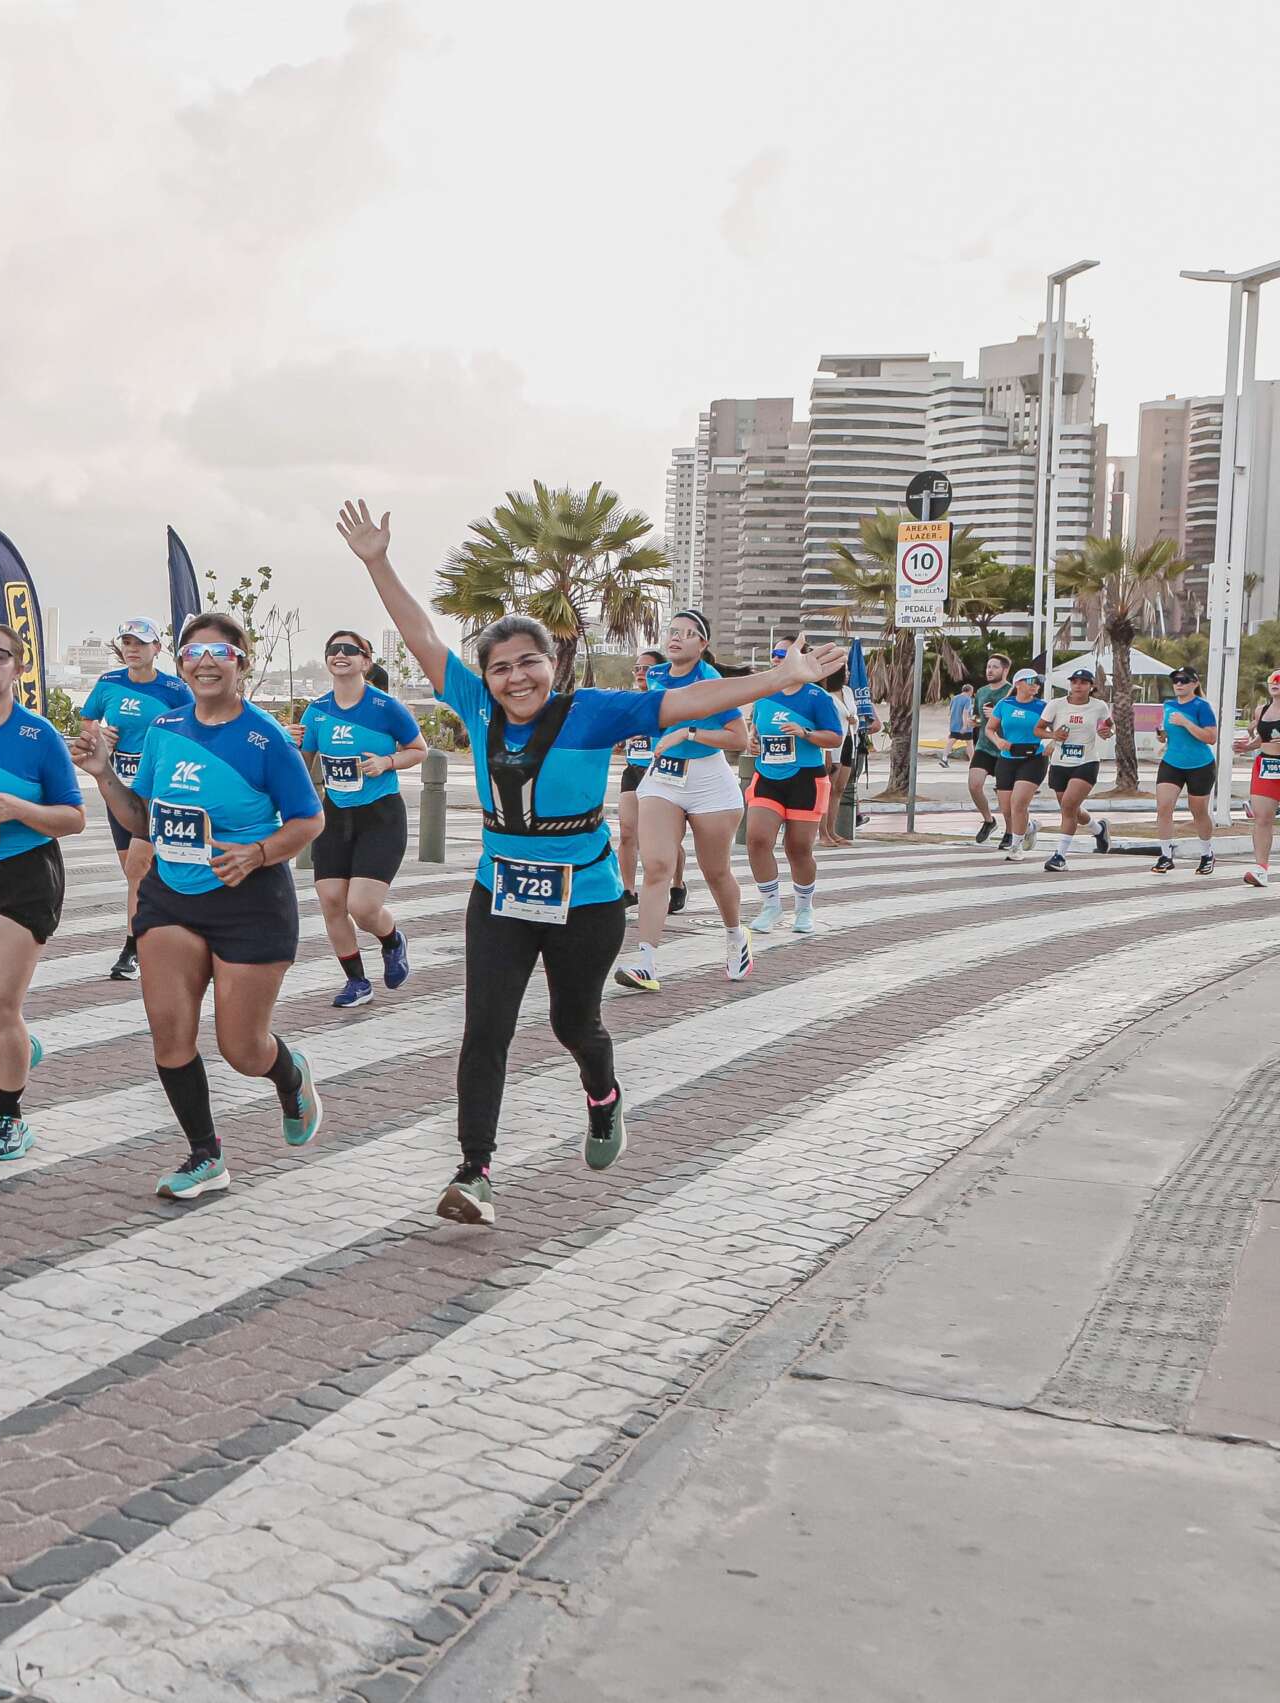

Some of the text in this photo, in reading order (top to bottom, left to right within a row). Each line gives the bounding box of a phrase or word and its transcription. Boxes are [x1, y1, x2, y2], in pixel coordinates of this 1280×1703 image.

[910, 553, 934, 570] 10
[905, 604, 933, 613] PEDALE
[769, 743, 787, 752] 626
[120, 764, 137, 774] 140
[660, 758, 678, 771] 911
[332, 766, 352, 777] 514
[164, 820, 196, 839] 844
[516, 876, 552, 897] 728
